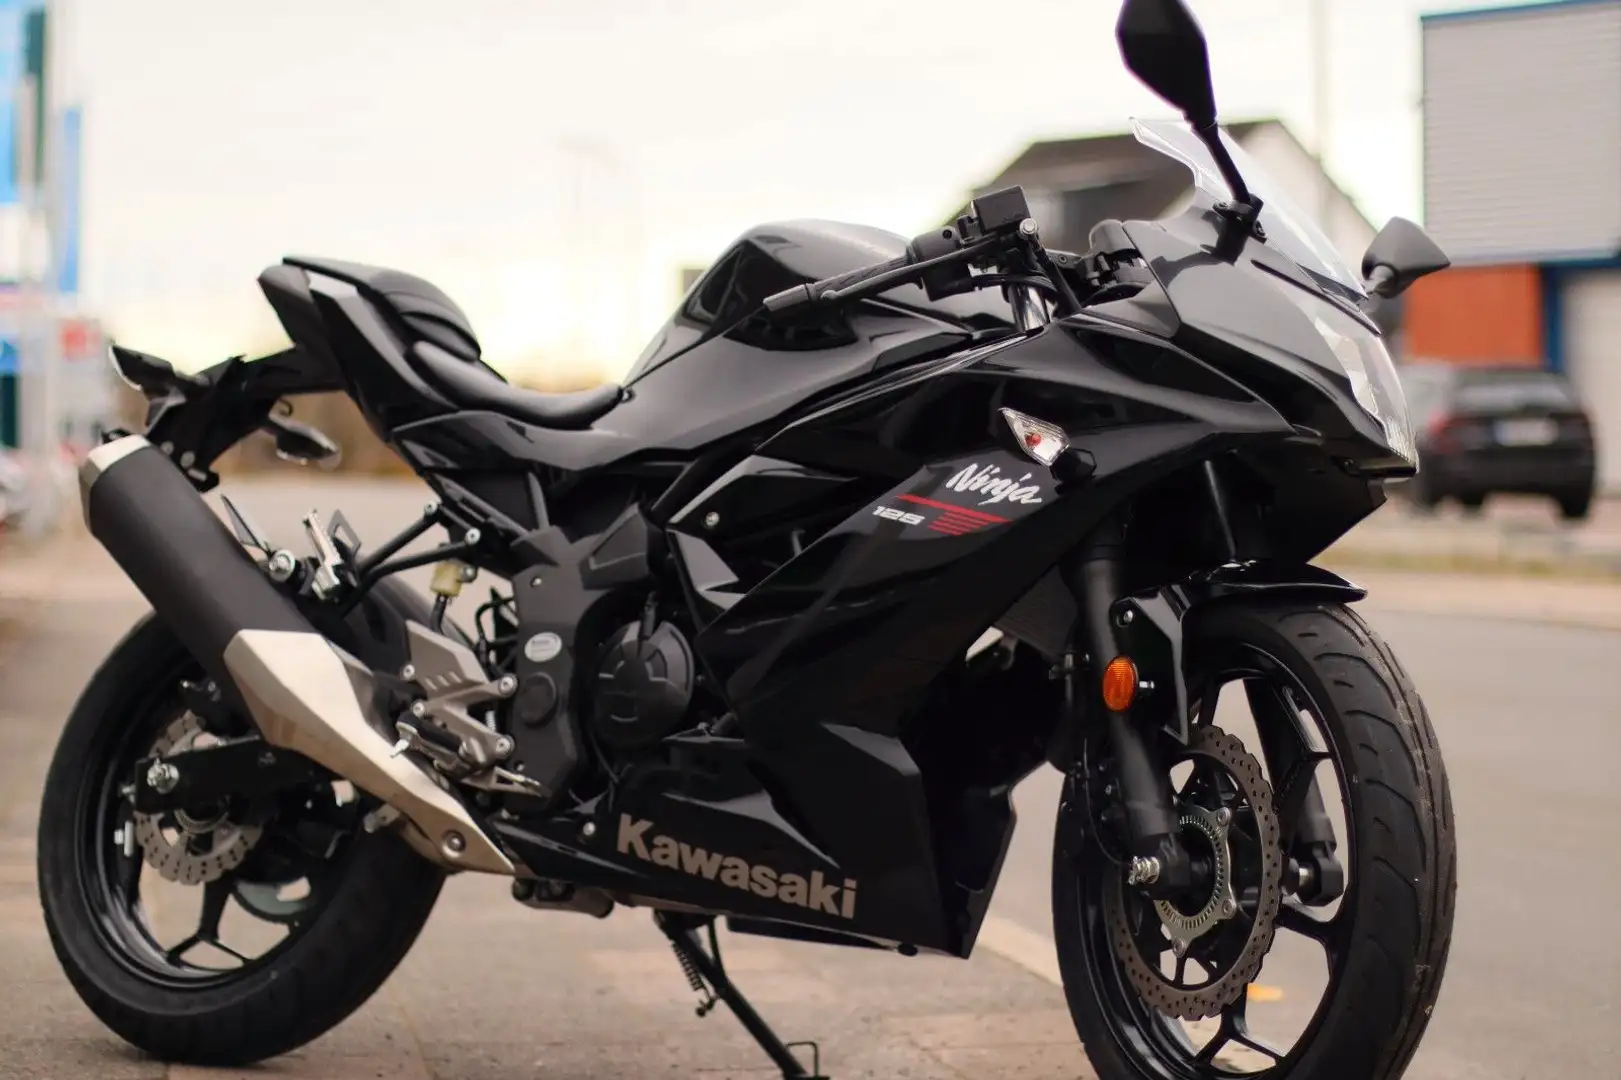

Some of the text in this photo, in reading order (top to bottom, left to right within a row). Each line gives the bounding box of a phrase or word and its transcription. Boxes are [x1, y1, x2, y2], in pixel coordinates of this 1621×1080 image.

[945, 463, 1042, 506] Ninja
[872, 505, 925, 525] 125
[616, 812, 857, 919] Kawasaki
